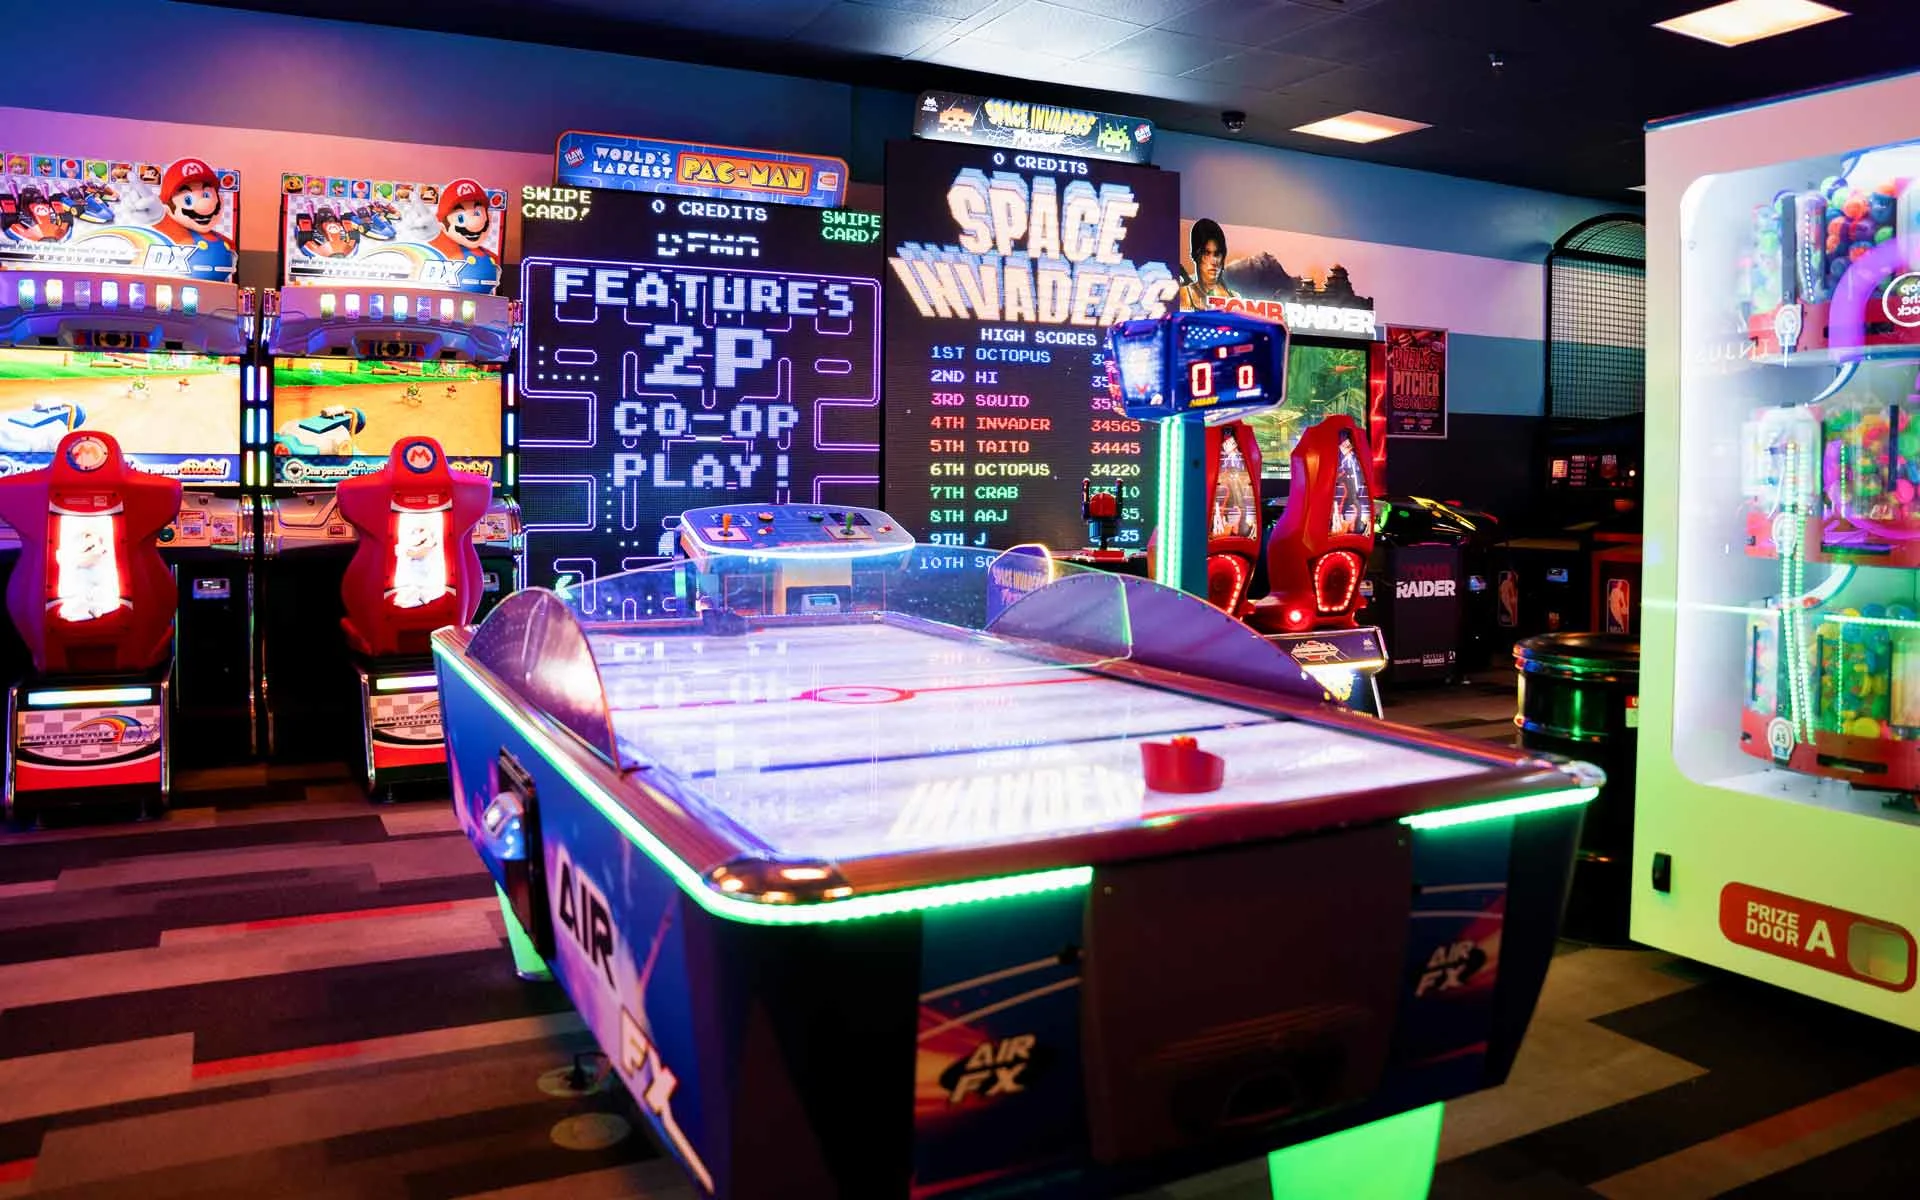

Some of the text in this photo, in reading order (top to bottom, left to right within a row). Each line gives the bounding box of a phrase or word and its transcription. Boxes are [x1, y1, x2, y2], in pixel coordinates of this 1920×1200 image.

[984, 98, 1031, 129] SPACE
[1030, 104, 1097, 137] INVADERS
[595, 146, 671, 165] WORLD'S
[993, 152, 1088, 175] 0 CREDITS
[592, 160, 673, 179] LARGEST
[682, 158, 808, 190] PAC-MAN
[522, 186, 592, 204] SWIPE
[522, 204, 591, 221] CARD!
[652, 199, 768, 221] 0 CREDITS
[822, 210, 881, 228] SWIPE
[947, 168, 1140, 265] SPACE
[822, 227, 880, 243] CARD!
[144, 244, 199, 273] DX
[420, 259, 469, 288] DX
[554, 266, 854, 317] FEATURES
[888, 246, 1180, 328] INVADERS
[1284, 302, 1376, 334] RAIDER
[981, 327, 1097, 346] HIGH SCORES
[644, 325, 773, 388] 2P
[931, 345, 1051, 363] 1ST OCTOPUS
[931, 369, 999, 384] 2ND HI
[1191, 362, 1212, 397] 0
[1238, 365, 1254, 389] 0
[1392, 371, 1440, 396] PITCHER
[931, 393, 1030, 408] 3RD SQUID
[613, 400, 799, 439] CO-OP
[931, 416, 1141, 432] 4TH INVADER 34565
[930, 440, 1141, 454] 5TH TAITO 34445
[613, 453, 790, 488] PLAY!
[930, 463, 1140, 476] 6TH OCTOPUS 34220
[930, 486, 964, 499] 7TH
[975, 486, 1019, 499] CRAB
[930, 509, 1008, 522] 8TH AAJ
[930, 533, 987, 545] 9TH J
[919, 557, 964, 569] 10TH
[1396, 580, 1456, 598] RAIDER
[558, 861, 616, 990] AIR
[1747, 901, 1800, 931] PRIZE
[1745, 917, 1799, 947] DOOR
[1804, 919, 1836, 958] A
[1427, 940, 1474, 968] AIR
[1414, 964, 1467, 998] FX
[966, 1033, 1036, 1070] AIR
[949, 1063, 1027, 1103] FX
